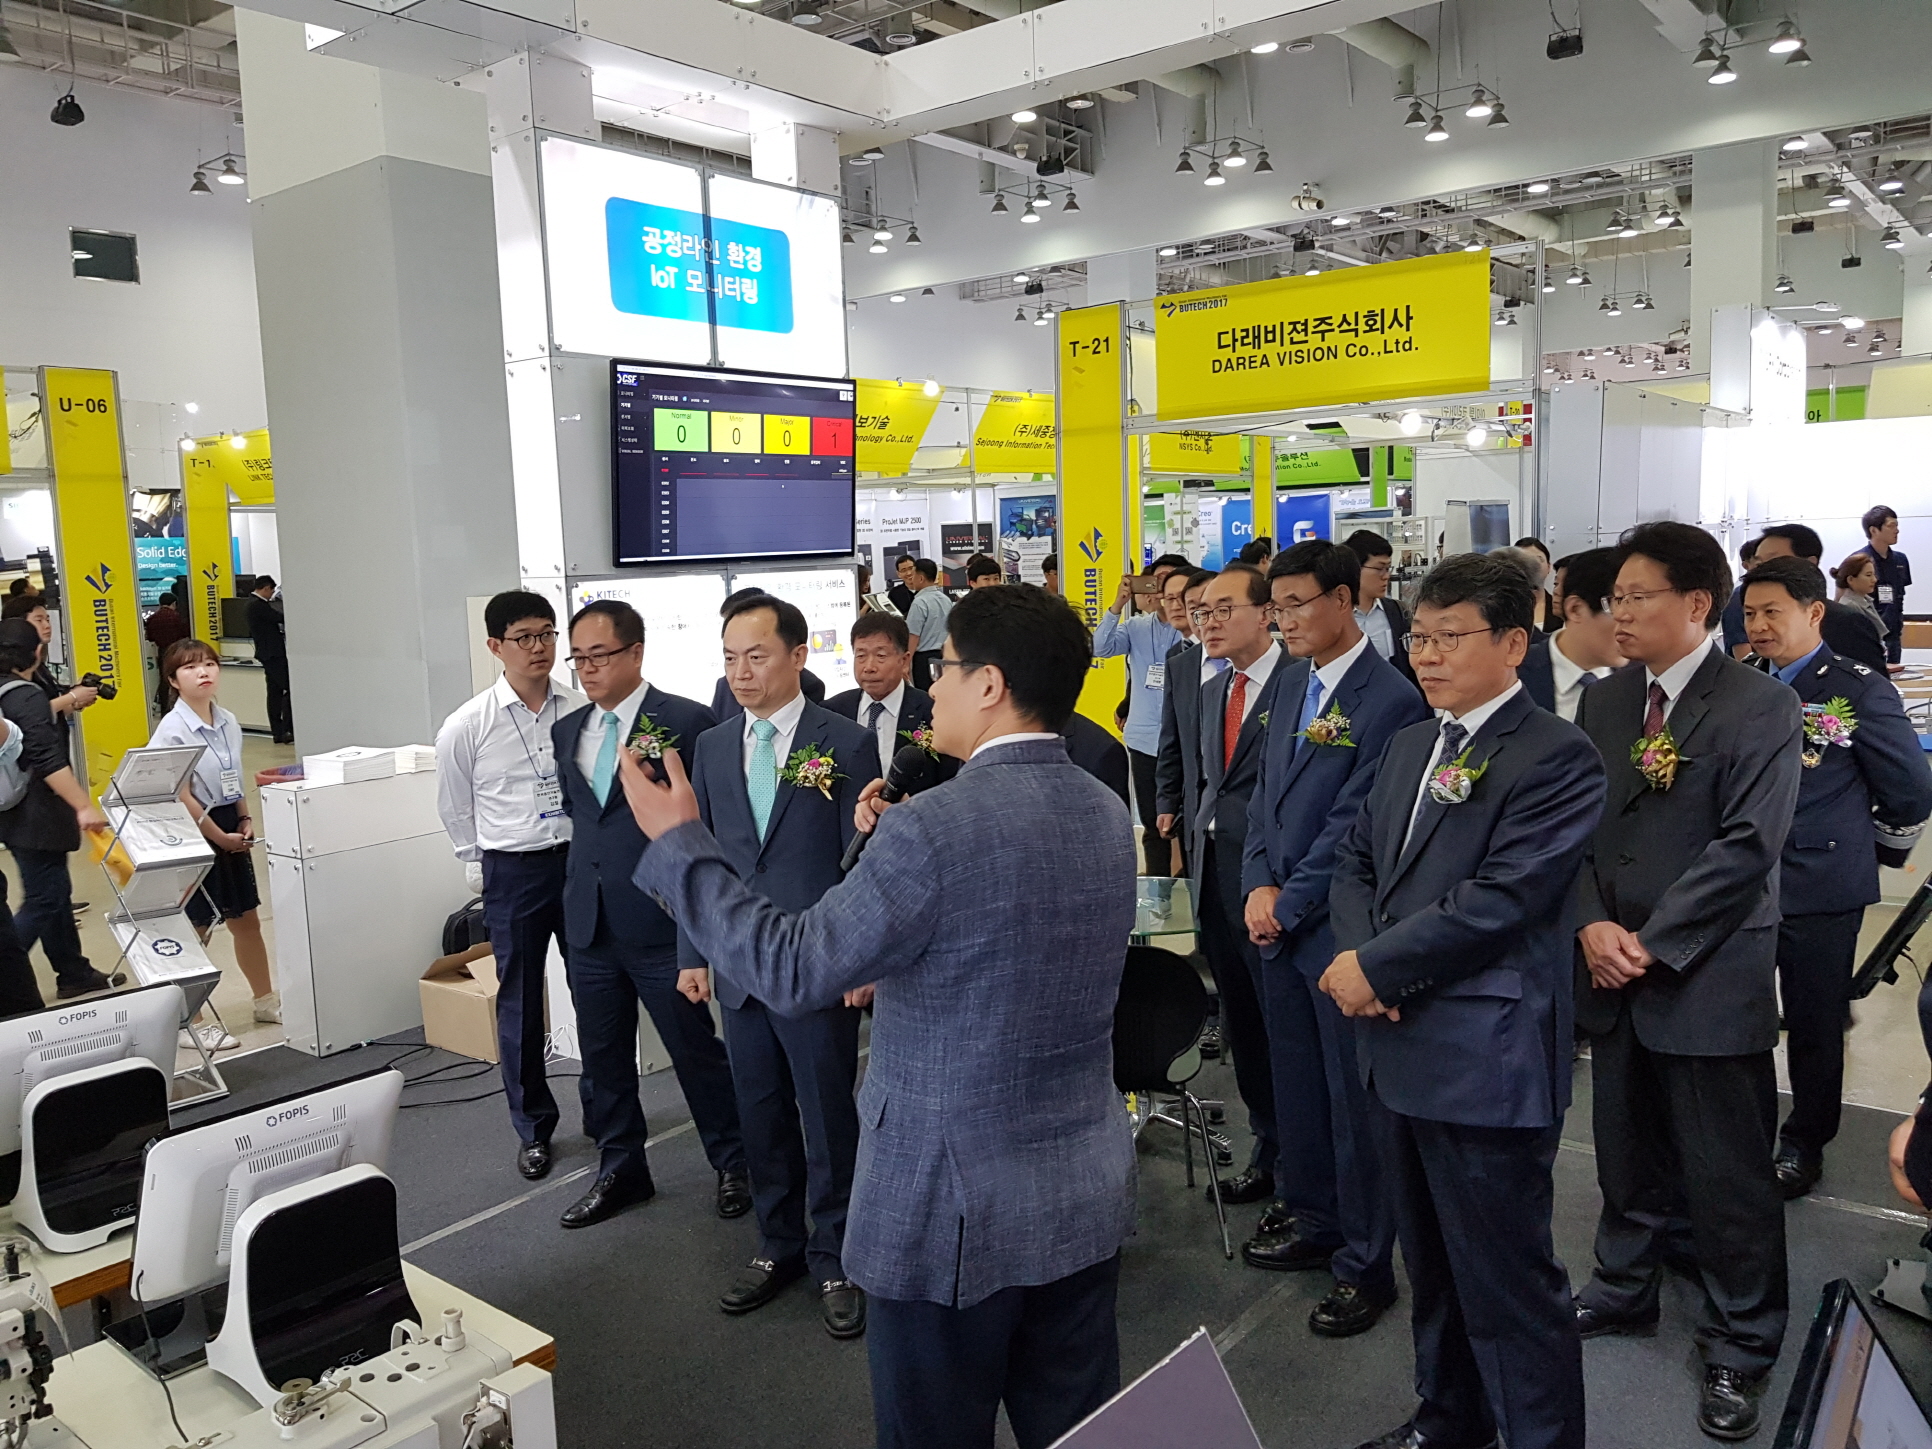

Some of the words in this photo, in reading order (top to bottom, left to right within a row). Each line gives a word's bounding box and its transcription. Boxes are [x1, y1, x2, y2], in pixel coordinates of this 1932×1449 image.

[642, 226, 720, 265] 공정라인
[727, 241, 763, 272] 환경
[651, 263, 679, 289] IoT
[686, 269, 759, 305] 모니터링
[1217, 304, 1414, 353] 다래비젼주식회사
[1069, 336, 1111, 357] T-21
[1211, 353, 1271, 374] DAREA
[1276, 344, 1338, 367] VISION
[59, 397, 108, 413] U-06
[671, 412, 692, 420] Normal
[780, 418, 794, 427] Major
[677, 425, 687, 443] 0
[732, 427, 742, 445] 0
[783, 430, 792, 447] 0
[831, 432, 838, 449] 1
[856, 434, 884, 444] hnology
[1005, 440, 1042, 450] Information
[1179, 443, 1194, 451] NSYS
[189, 458, 215, 468] T-1
[137, 546, 165, 558] Solid
[167, 546, 187, 560] Edg
[596, 589, 631, 600] KITECH
[70, 1009, 97, 1023] FOPIS
[278, 1104, 309, 1122] FOPIS
